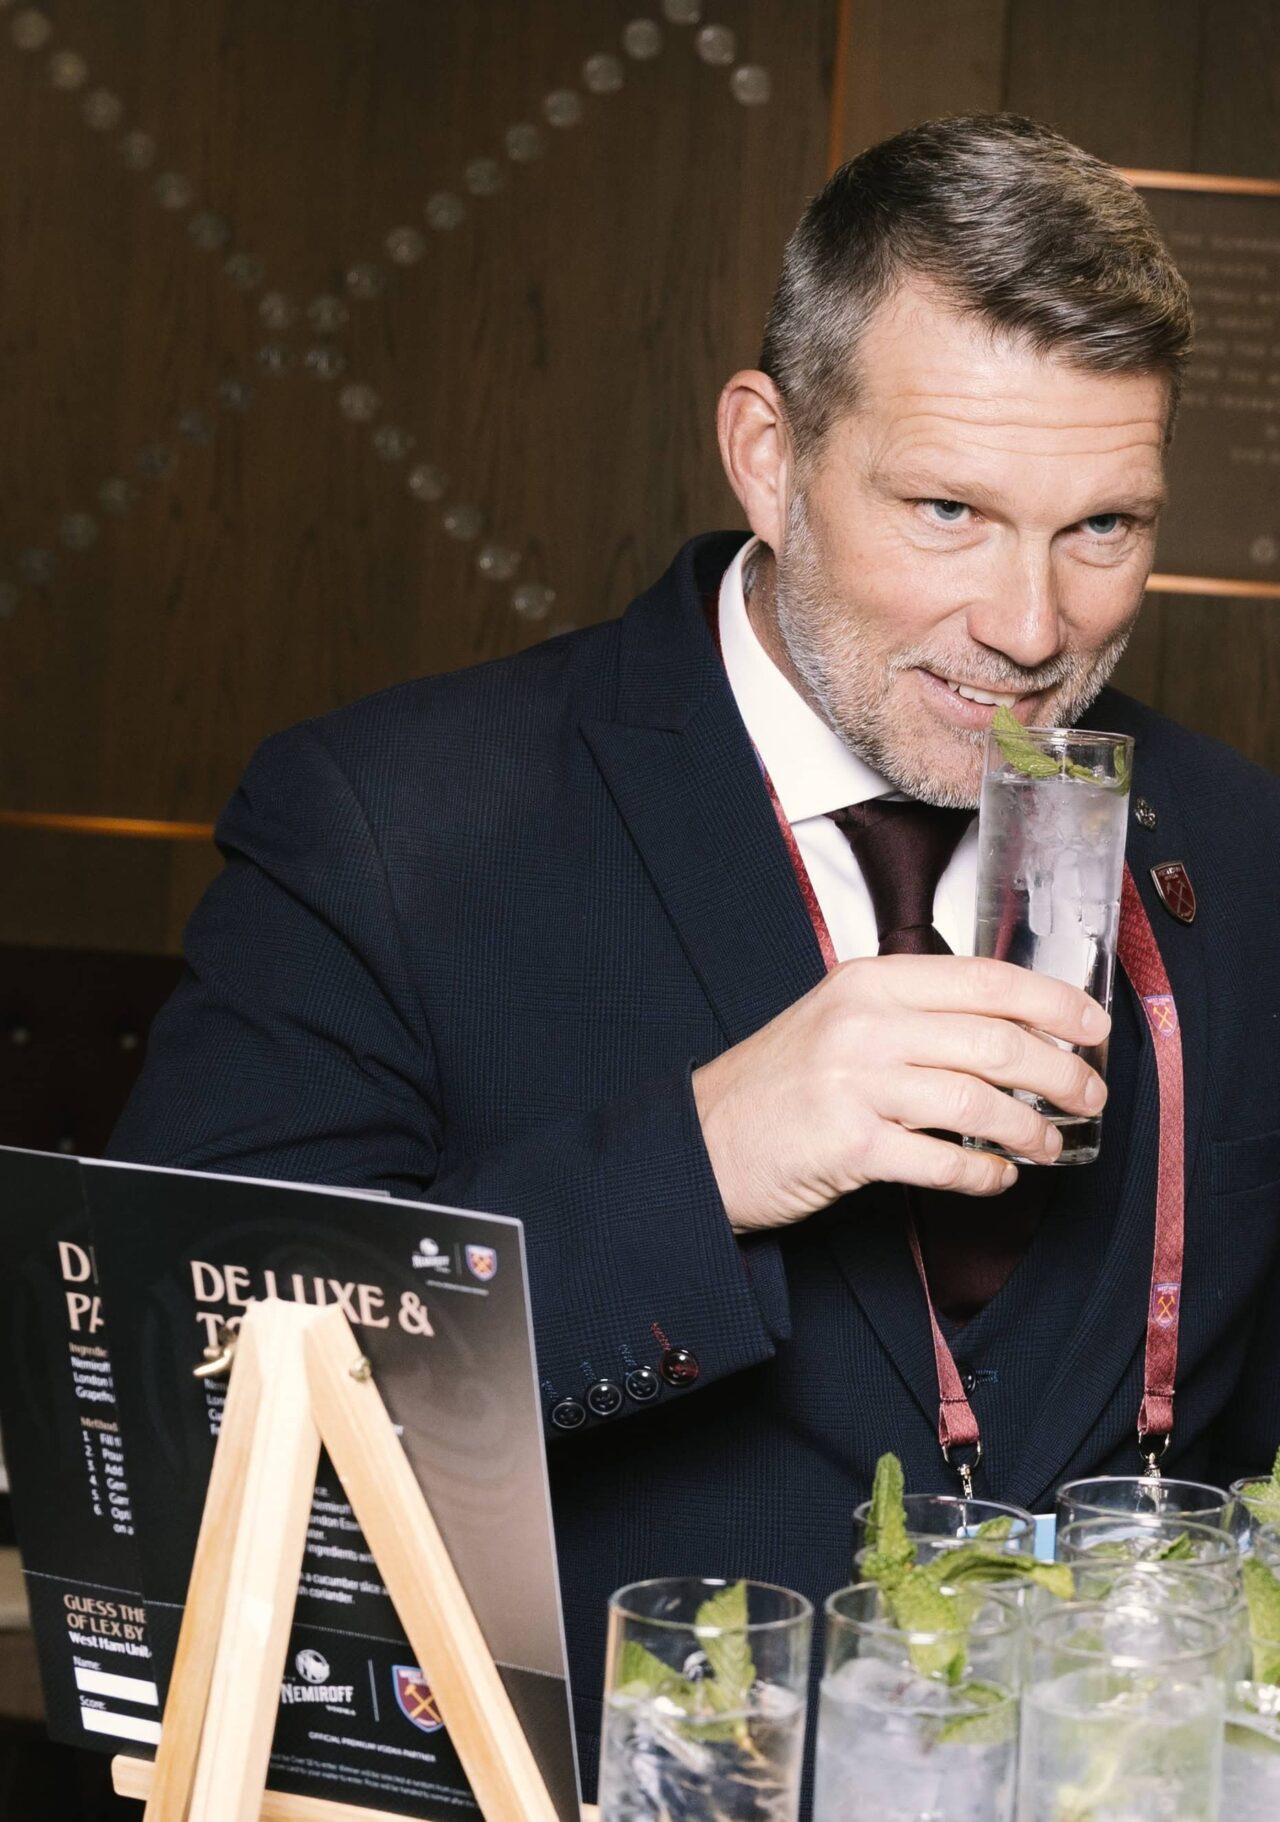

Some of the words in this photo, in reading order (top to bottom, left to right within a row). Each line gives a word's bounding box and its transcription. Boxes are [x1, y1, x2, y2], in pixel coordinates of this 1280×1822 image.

[190, 1260, 256, 1306] DE
[399, 1291, 435, 1337] &
[63, 1594, 117, 1618] GUESS
[67, 1613, 88, 1630] OF
[90, 1617, 122, 1638] LEX
[123, 1624, 144, 1642] BY
[68, 1631, 99, 1648] West
[99, 1637, 125, 1654] Ham
[281, 1682, 355, 1704] NEMIROFF
